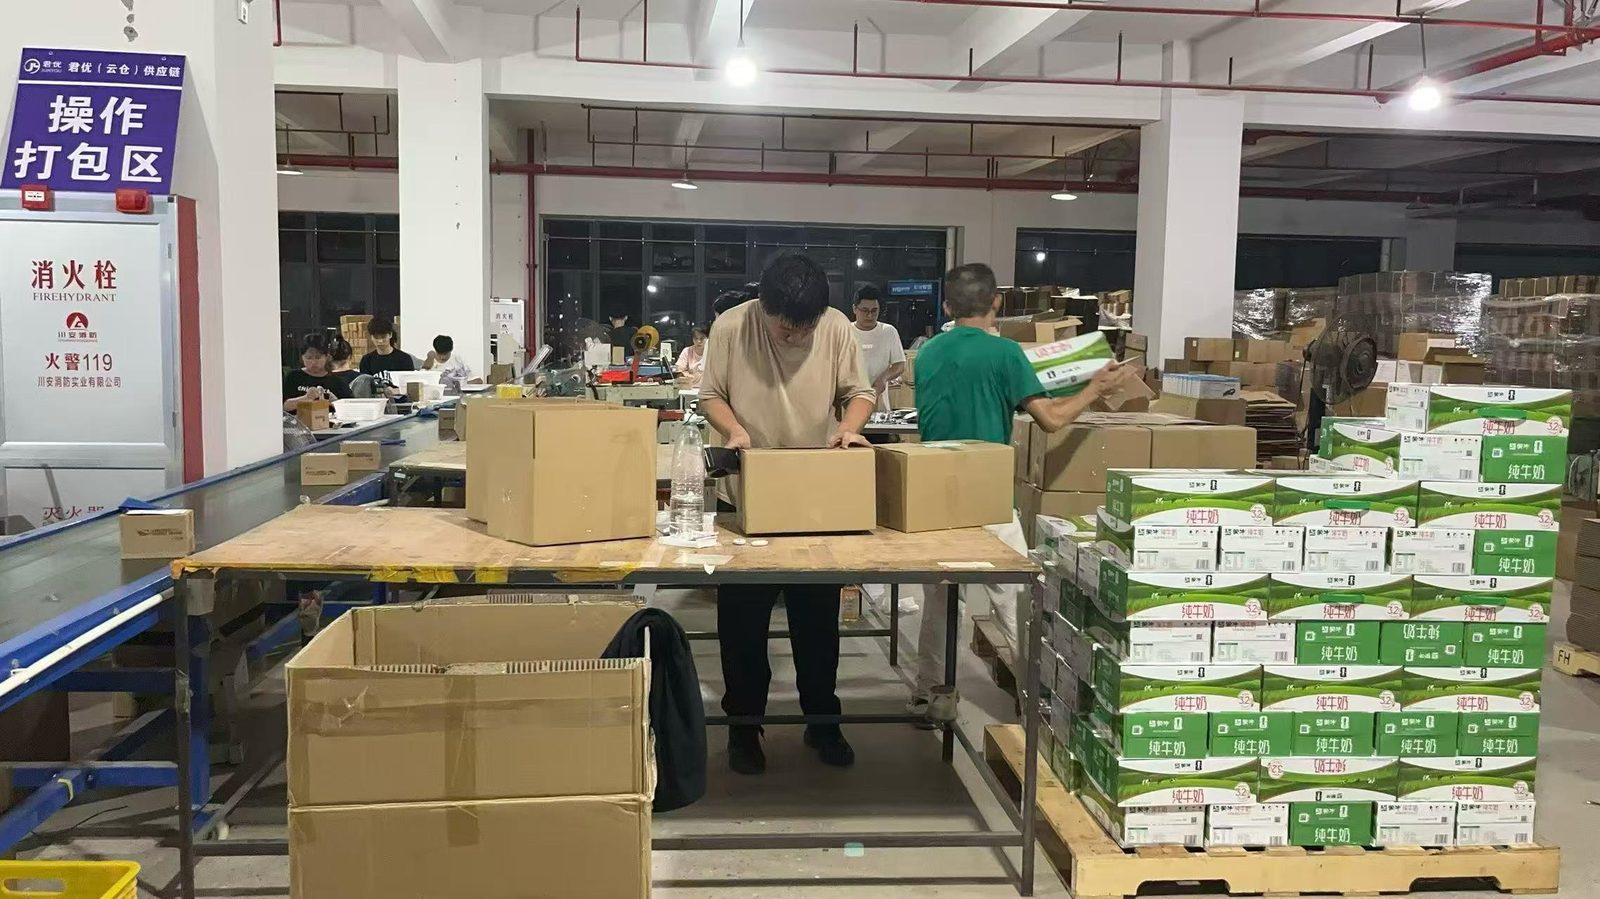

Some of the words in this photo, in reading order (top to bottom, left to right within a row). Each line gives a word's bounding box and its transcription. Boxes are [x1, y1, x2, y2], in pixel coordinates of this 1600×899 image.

[42, 60, 62, 68] 君优
[48, 95, 147, 135] 操作
[14, 140, 163, 182] 打包区
[32, 260, 117, 289] 消火栓
[33, 292, 116, 301] FIREHYDRANT
[45, 353, 113, 371] 火警119
[38, 377, 121, 388] 川安消防实业有限公司
[1482, 420, 1515, 434] 纯牛奶
[1508, 464, 1544, 480] 纯牛奶
[1186, 509, 1219, 524] 纯牛奶
[1329, 511, 1361, 526] 纯牛奶
[1474, 514, 1506, 528] 纯牛奶
[1499, 558, 1535, 574] 纯牛奶
[1182, 604, 1214, 618] 纯牛奶
[1323, 605, 1356, 619] 纯牛奶
[1464, 608, 1496, 620] 纯牛奶
[1321, 646, 1358, 661] 纯牛奶
[1488, 649, 1524, 664] 纯牛奶
[1558, 650, 1570, 664] FH
[1175, 696, 1207, 710] 纯牛奶
[1316, 696, 1348, 710] 纯牛奶
[1457, 696, 1488, 710] 纯牛奶
[1149, 741, 1186, 756] 纯牛奶
[1234, 740, 1270, 754] 纯牛奶
[1316, 738, 1352, 752] 纯牛奶
[1401, 739, 1436, 754] 纯牛奶
[1483, 739, 1518, 753] 纯牛奶
[1172, 789, 1204, 803] 纯牛奶
[1452, 786, 1482, 800] 纯牛奶
[1315, 828, 1350, 842] 纯牛奶
